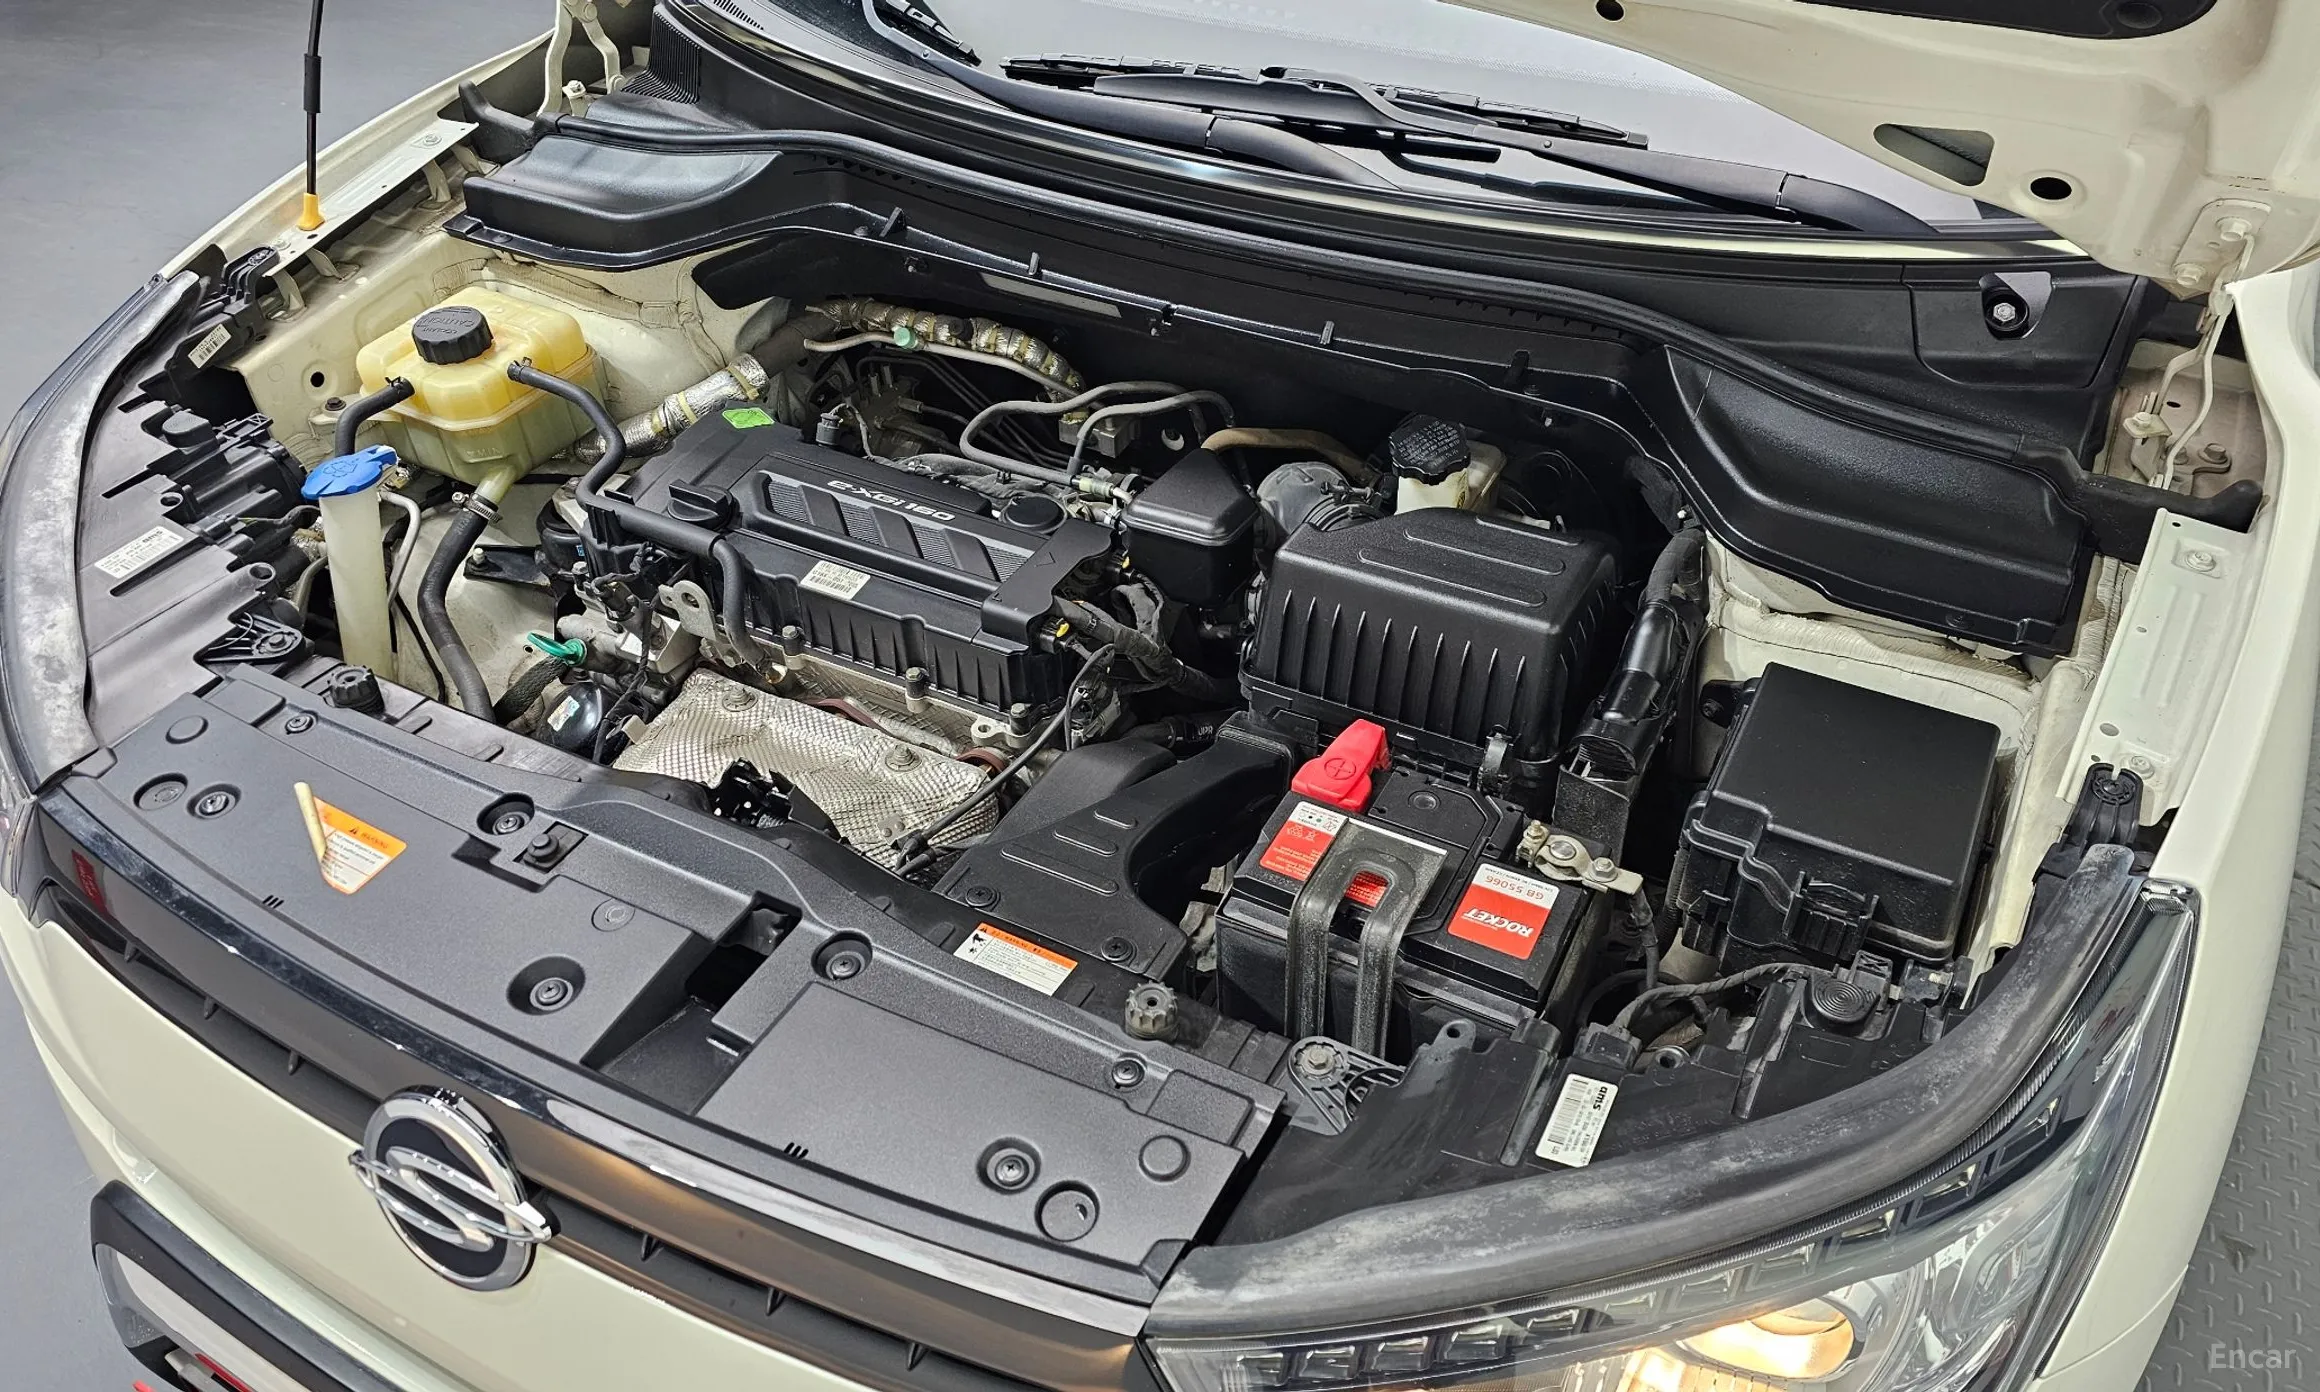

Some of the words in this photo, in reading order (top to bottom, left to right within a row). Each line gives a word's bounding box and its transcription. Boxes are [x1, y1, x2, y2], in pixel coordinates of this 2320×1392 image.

[904, 502, 956, 521] 160
[1485, 875, 1524, 893] 55066
[1526, 888, 1545, 900] GB
[1462, 908, 1535, 938] ROCKET
[1592, 1086, 1609, 1111] ams
